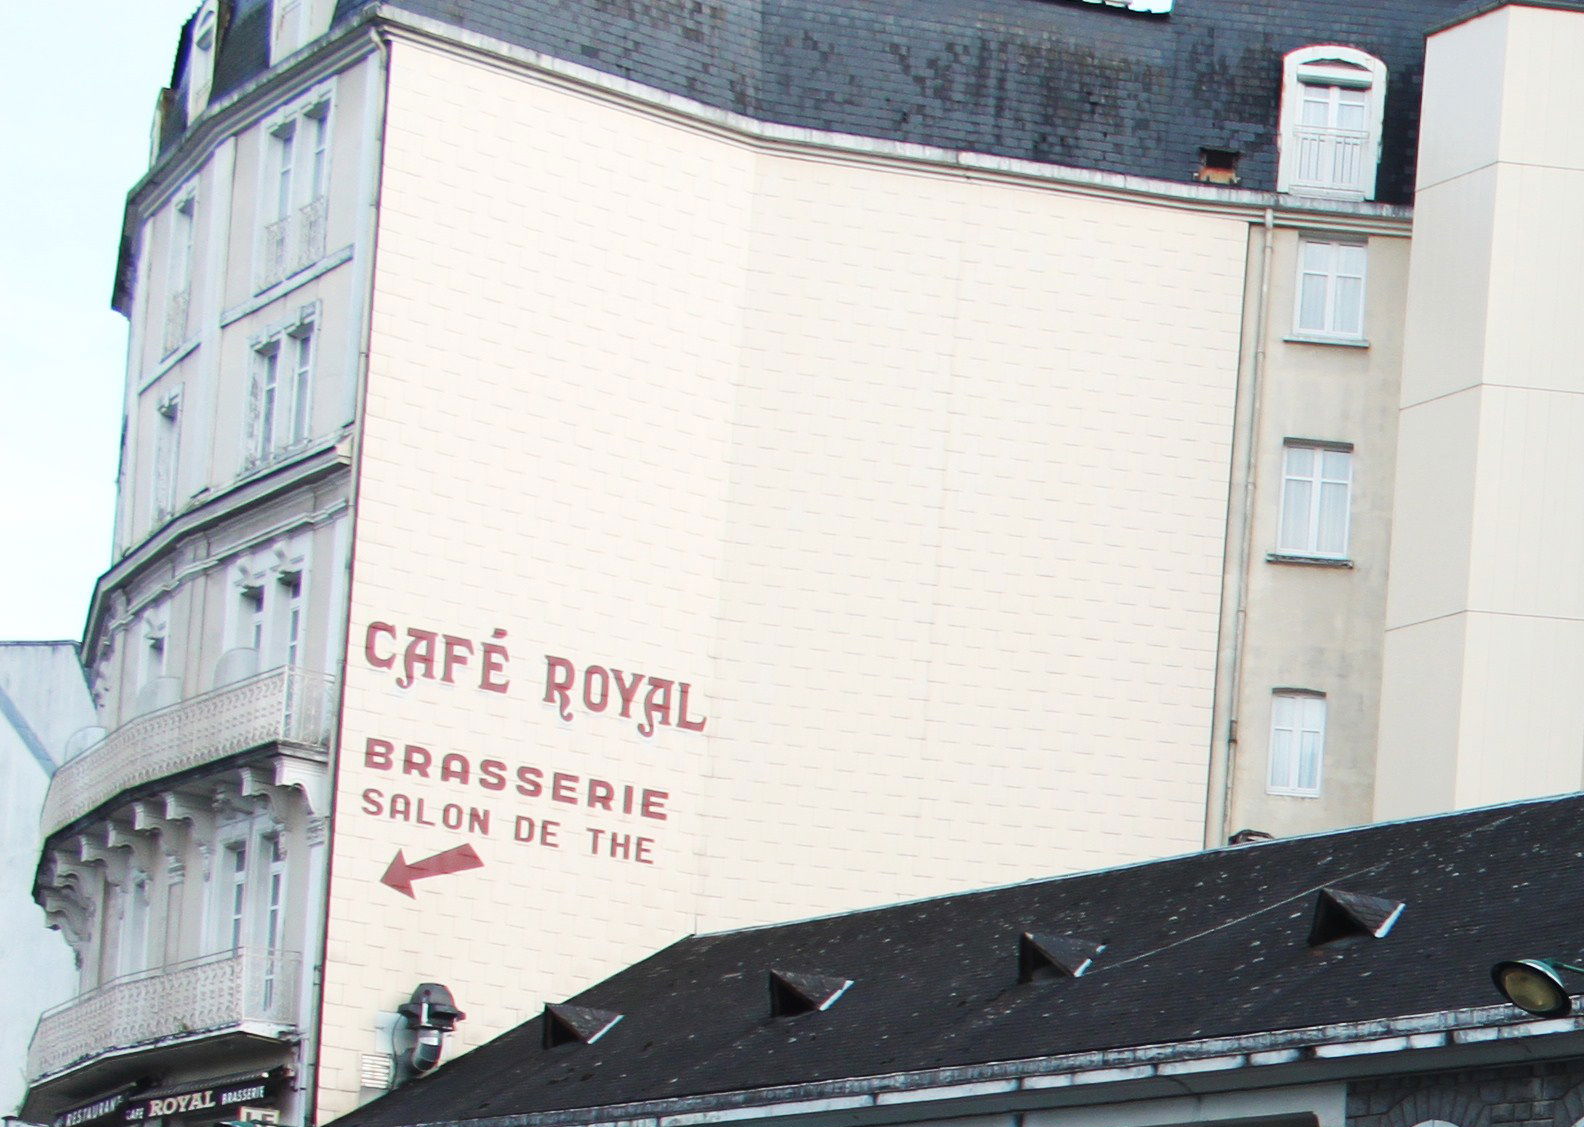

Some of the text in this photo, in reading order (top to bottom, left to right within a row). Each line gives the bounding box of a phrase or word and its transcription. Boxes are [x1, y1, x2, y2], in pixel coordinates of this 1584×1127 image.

[365, 621, 707, 737] CAFÉ ROYAL
[365, 737, 669, 820] BRASSERIE
[361, 788, 655, 864] SALON DE THE
[149, 1090, 216, 1117] ROYAL
[222, 1086, 265, 1105] BRASSERIE
